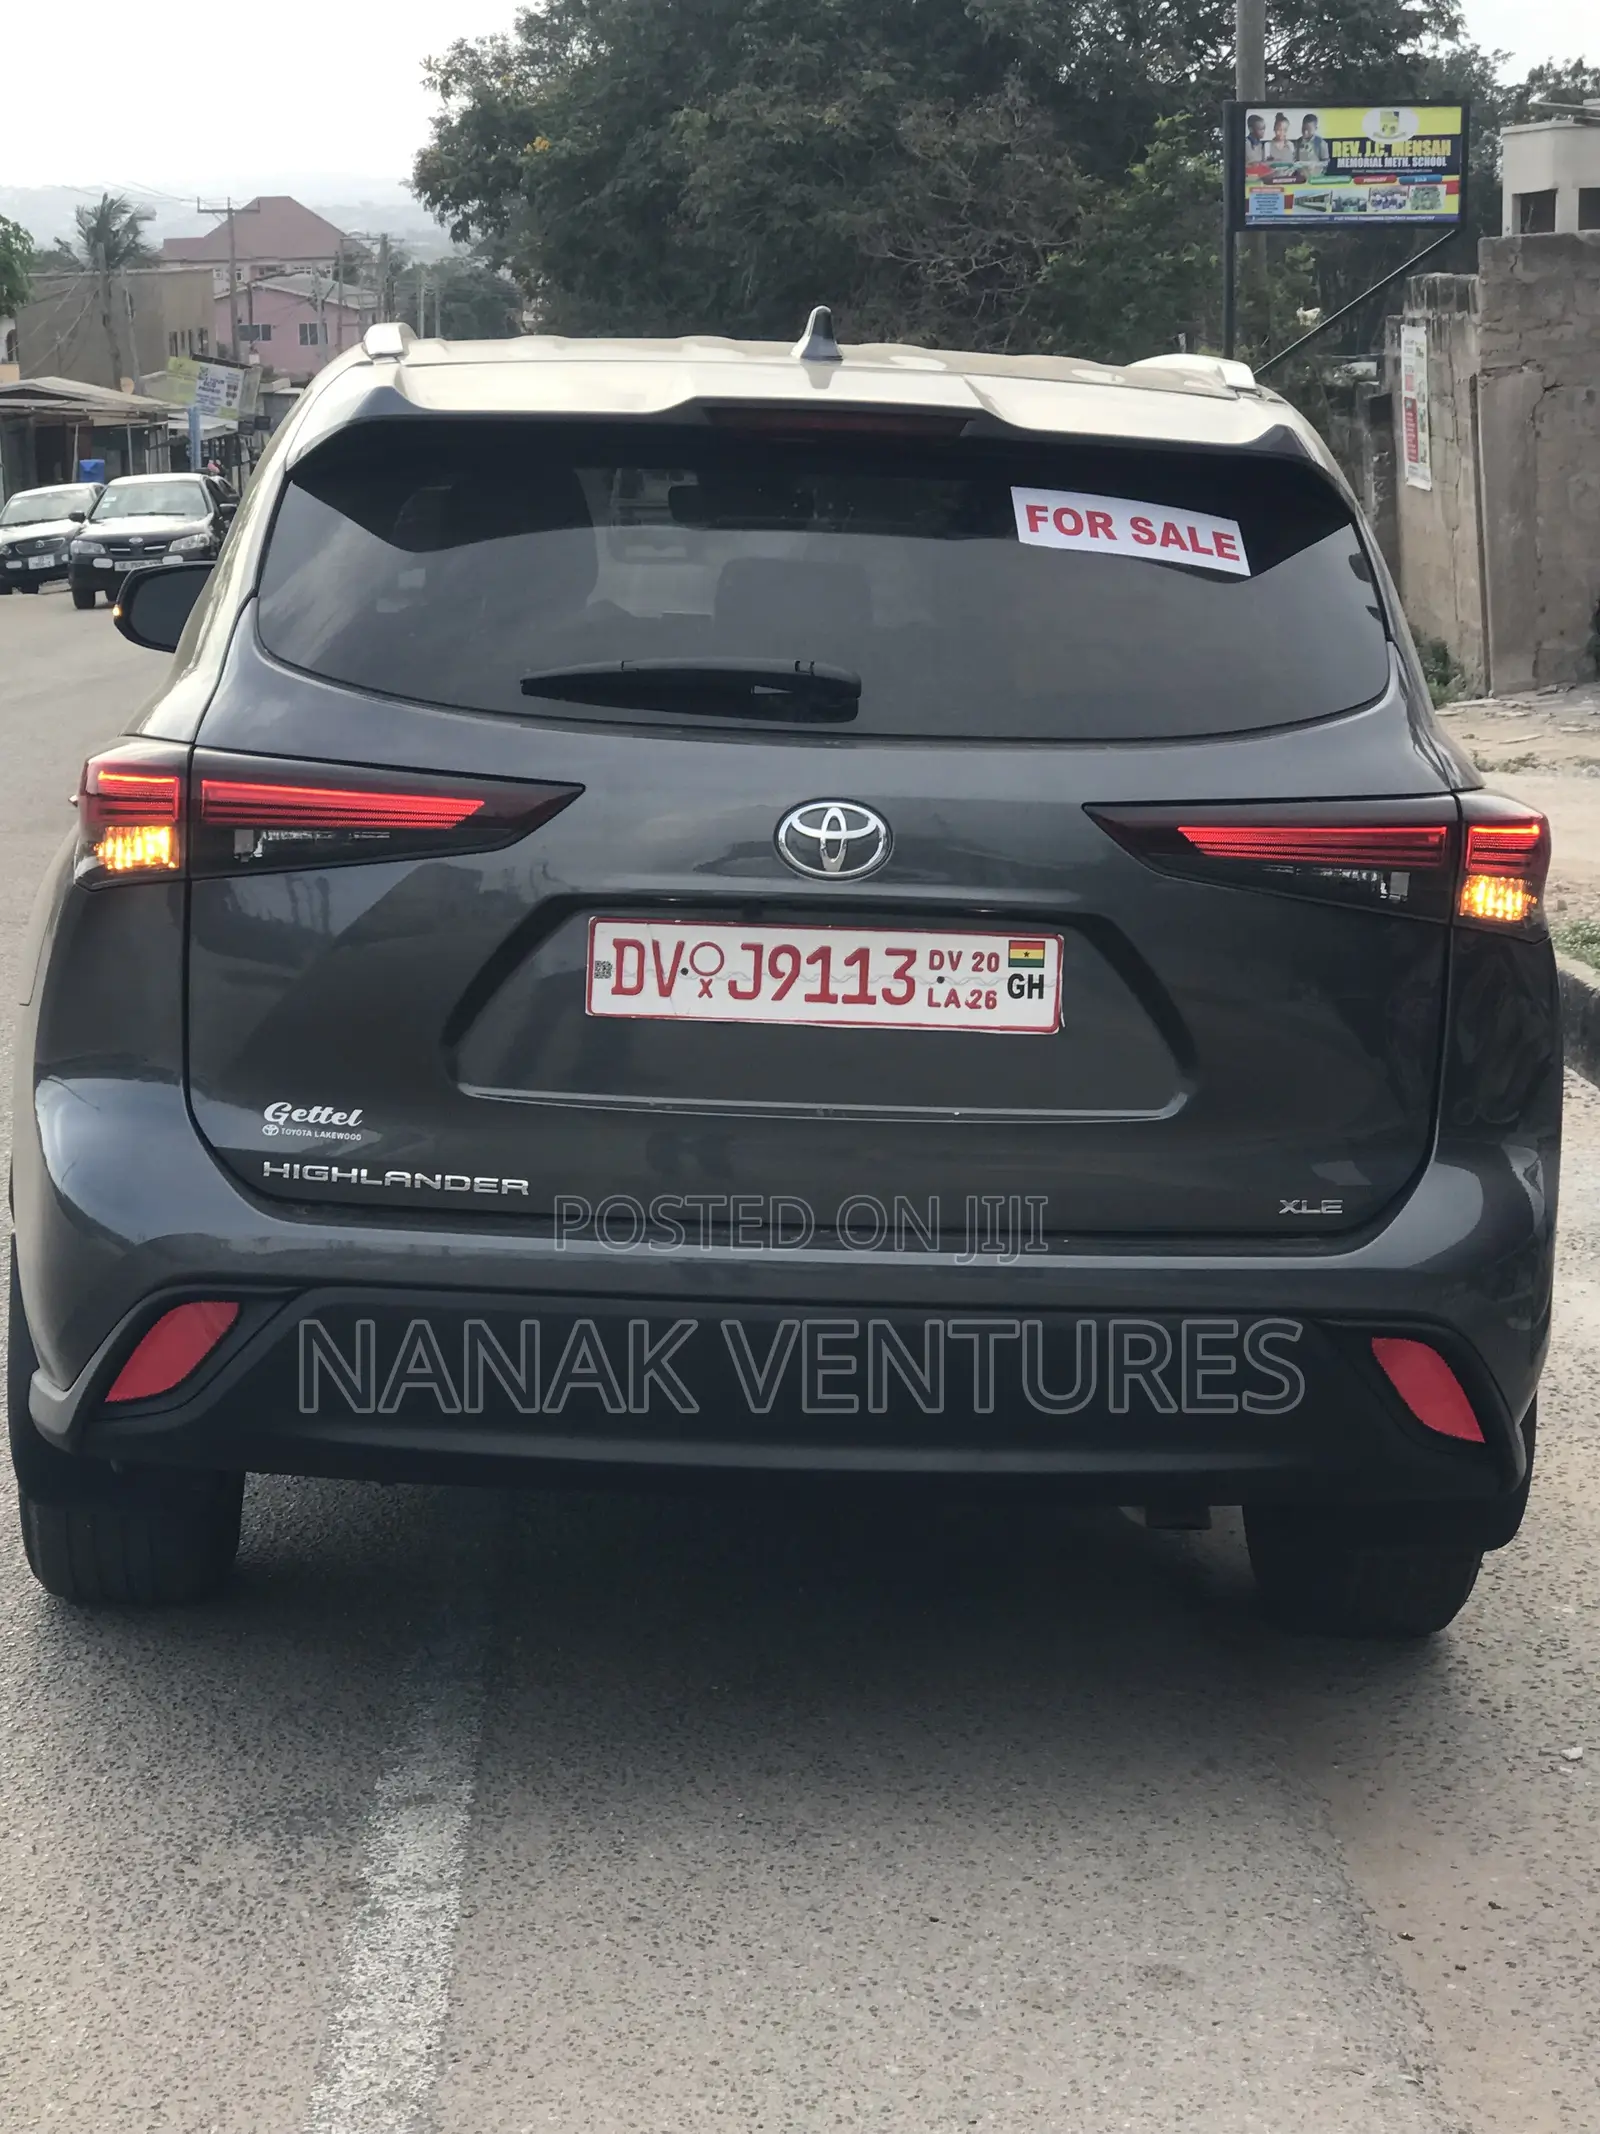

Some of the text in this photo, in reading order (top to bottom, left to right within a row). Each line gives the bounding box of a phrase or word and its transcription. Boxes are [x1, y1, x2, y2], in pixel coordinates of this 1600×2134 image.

[1331, 140, 1362, 158] REV.
[1391, 139, 1452, 157] MENSAH
[1336, 156, 1447, 169] MEMORIAL METH. SCHOOL
[1025, 504, 1240, 562] FOR SALE
[611, 938, 686, 998] DV
[728, 941, 917, 1006] J9113
[928, 949, 1000, 973] DV 20
[927, 987, 997, 1010] LA 26
[1007, 973, 1045, 1000] GH
[263, 1101, 364, 1127] Gettel
[281, 1127, 362, 1141] TOYOTA LAKEWOOD
[262, 1160, 530, 1196] HIGHLANDER
[1279, 1199, 1344, 1215] XLE
